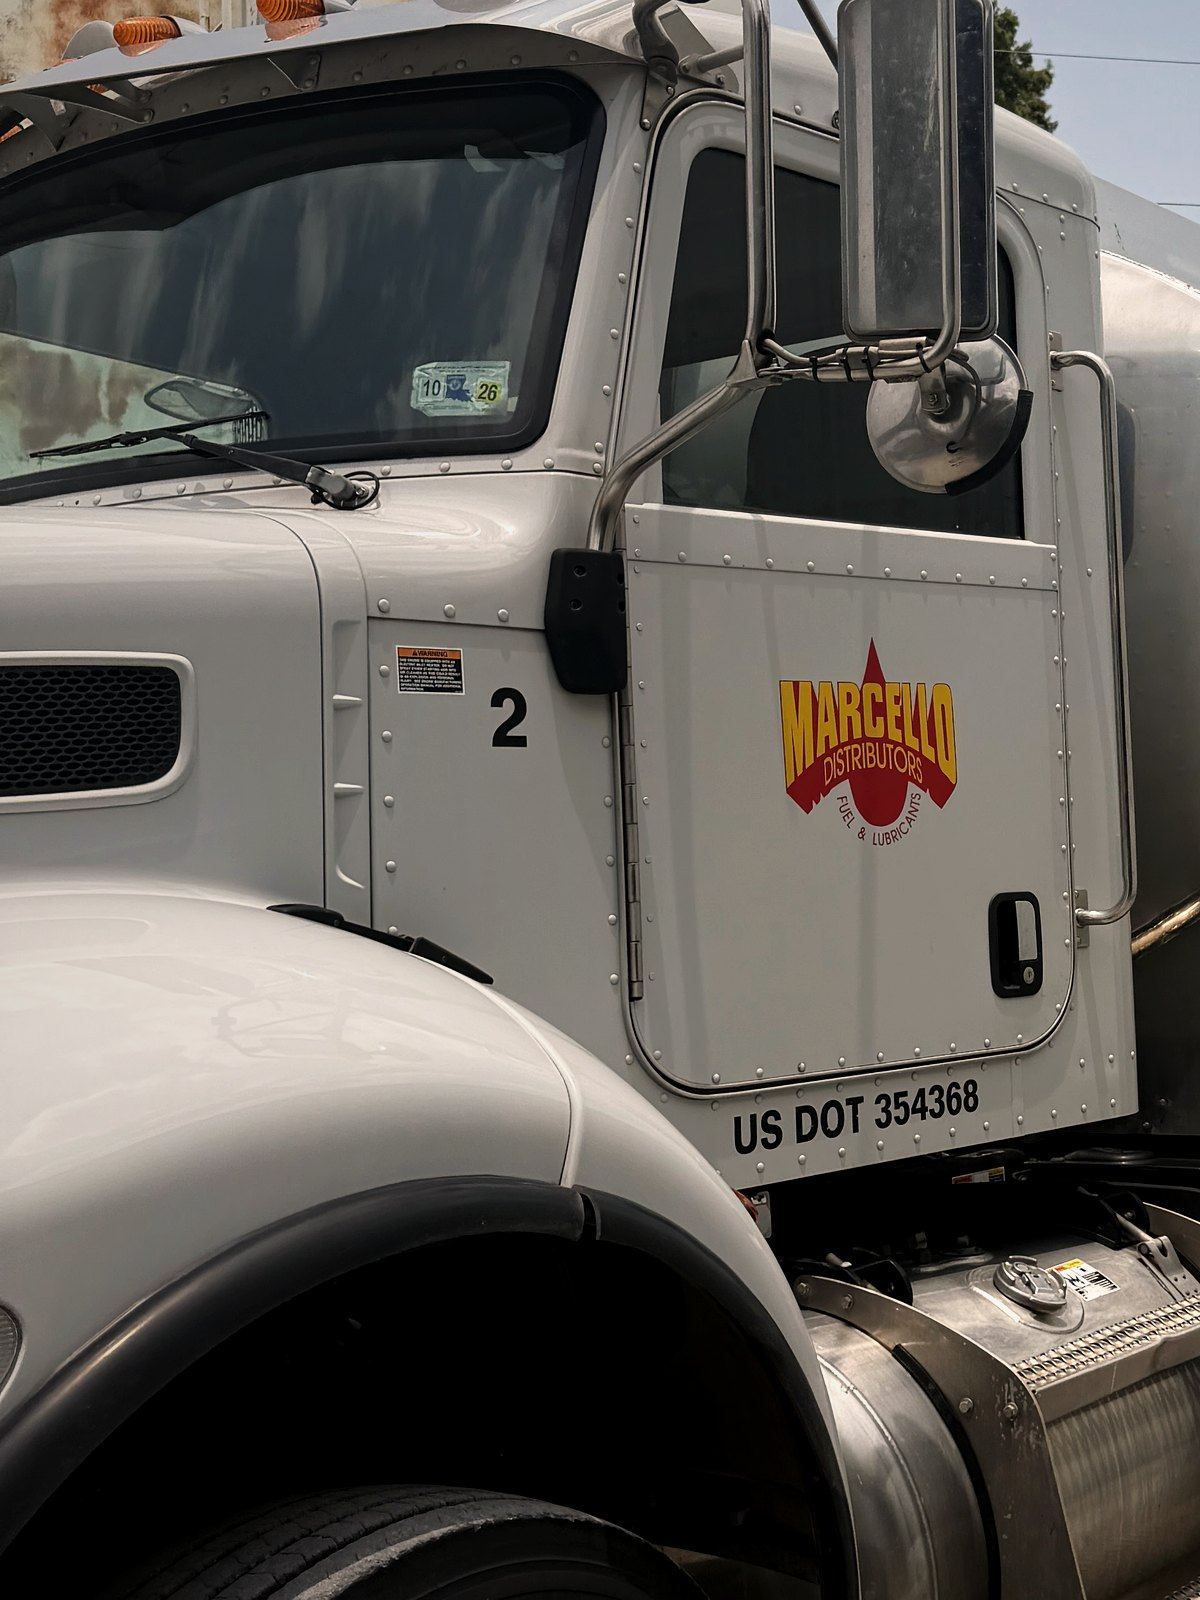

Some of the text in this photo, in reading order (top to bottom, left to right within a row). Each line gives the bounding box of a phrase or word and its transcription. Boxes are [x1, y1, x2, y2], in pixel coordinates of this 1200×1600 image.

[423, 379, 499, 401] 10 26
[490, 686, 528, 748] 2
[779, 680, 958, 788] MARCELLO
[823, 742, 923, 786] DISTRIBUTORS
[836, 792, 922, 847] FUEL & LUBRICANTS
[733, 1078, 980, 1155] US DOT 354368
